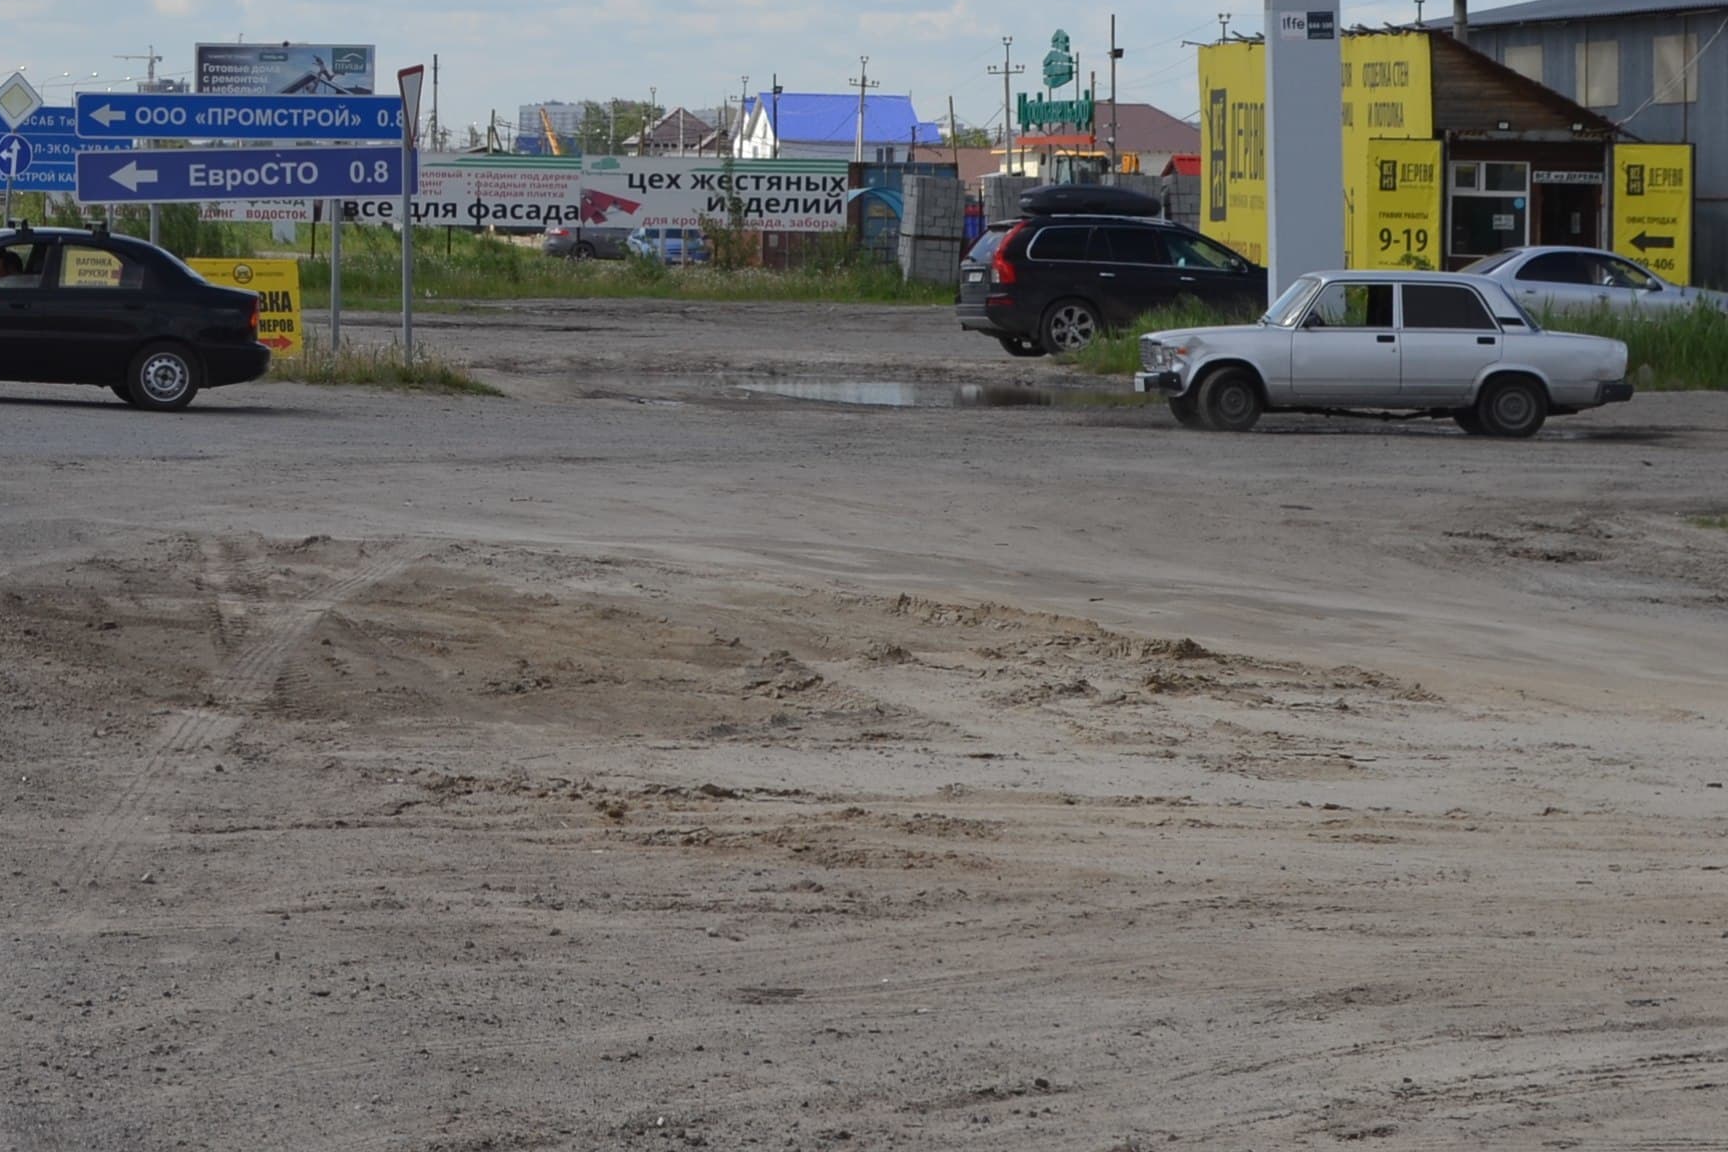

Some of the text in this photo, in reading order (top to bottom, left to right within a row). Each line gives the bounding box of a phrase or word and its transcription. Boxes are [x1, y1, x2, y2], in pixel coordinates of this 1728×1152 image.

[203, 63, 280, 74] Готовые дома
[1363, 61, 1391, 89] ОТДЕЛКА
[1393, 61, 1408, 88] СТЕН
[211, 75, 268, 85] ремонтом
[60, 115, 75, 127] Тю
[135, 106, 187, 126] ООО
[195, 103, 362, 129] «ПРОМСТРОЙ»
[189, 160, 389, 191] ЕвроСТО 0.8
[421, 170, 462, 178] иловый
[474, 171, 518, 181] сайдинг
[520, 172, 540, 181] под
[541, 173, 579, 182] дерево
[529, 182, 568, 190] панели
[628, 173, 846, 193] цех жестяных
[531, 190, 564, 199] плитка
[199, 209, 306, 220] динг водосток
[344, 200, 393, 217] все
[467, 198, 580, 225] фасада
[642, 217, 668, 228] для
[789, 217, 838, 230] забора
[1379, 228, 1428, 252] 9-19
[258, 291, 292, 313] ВКА
[259, 319, 294, 333] НЕРОВ
